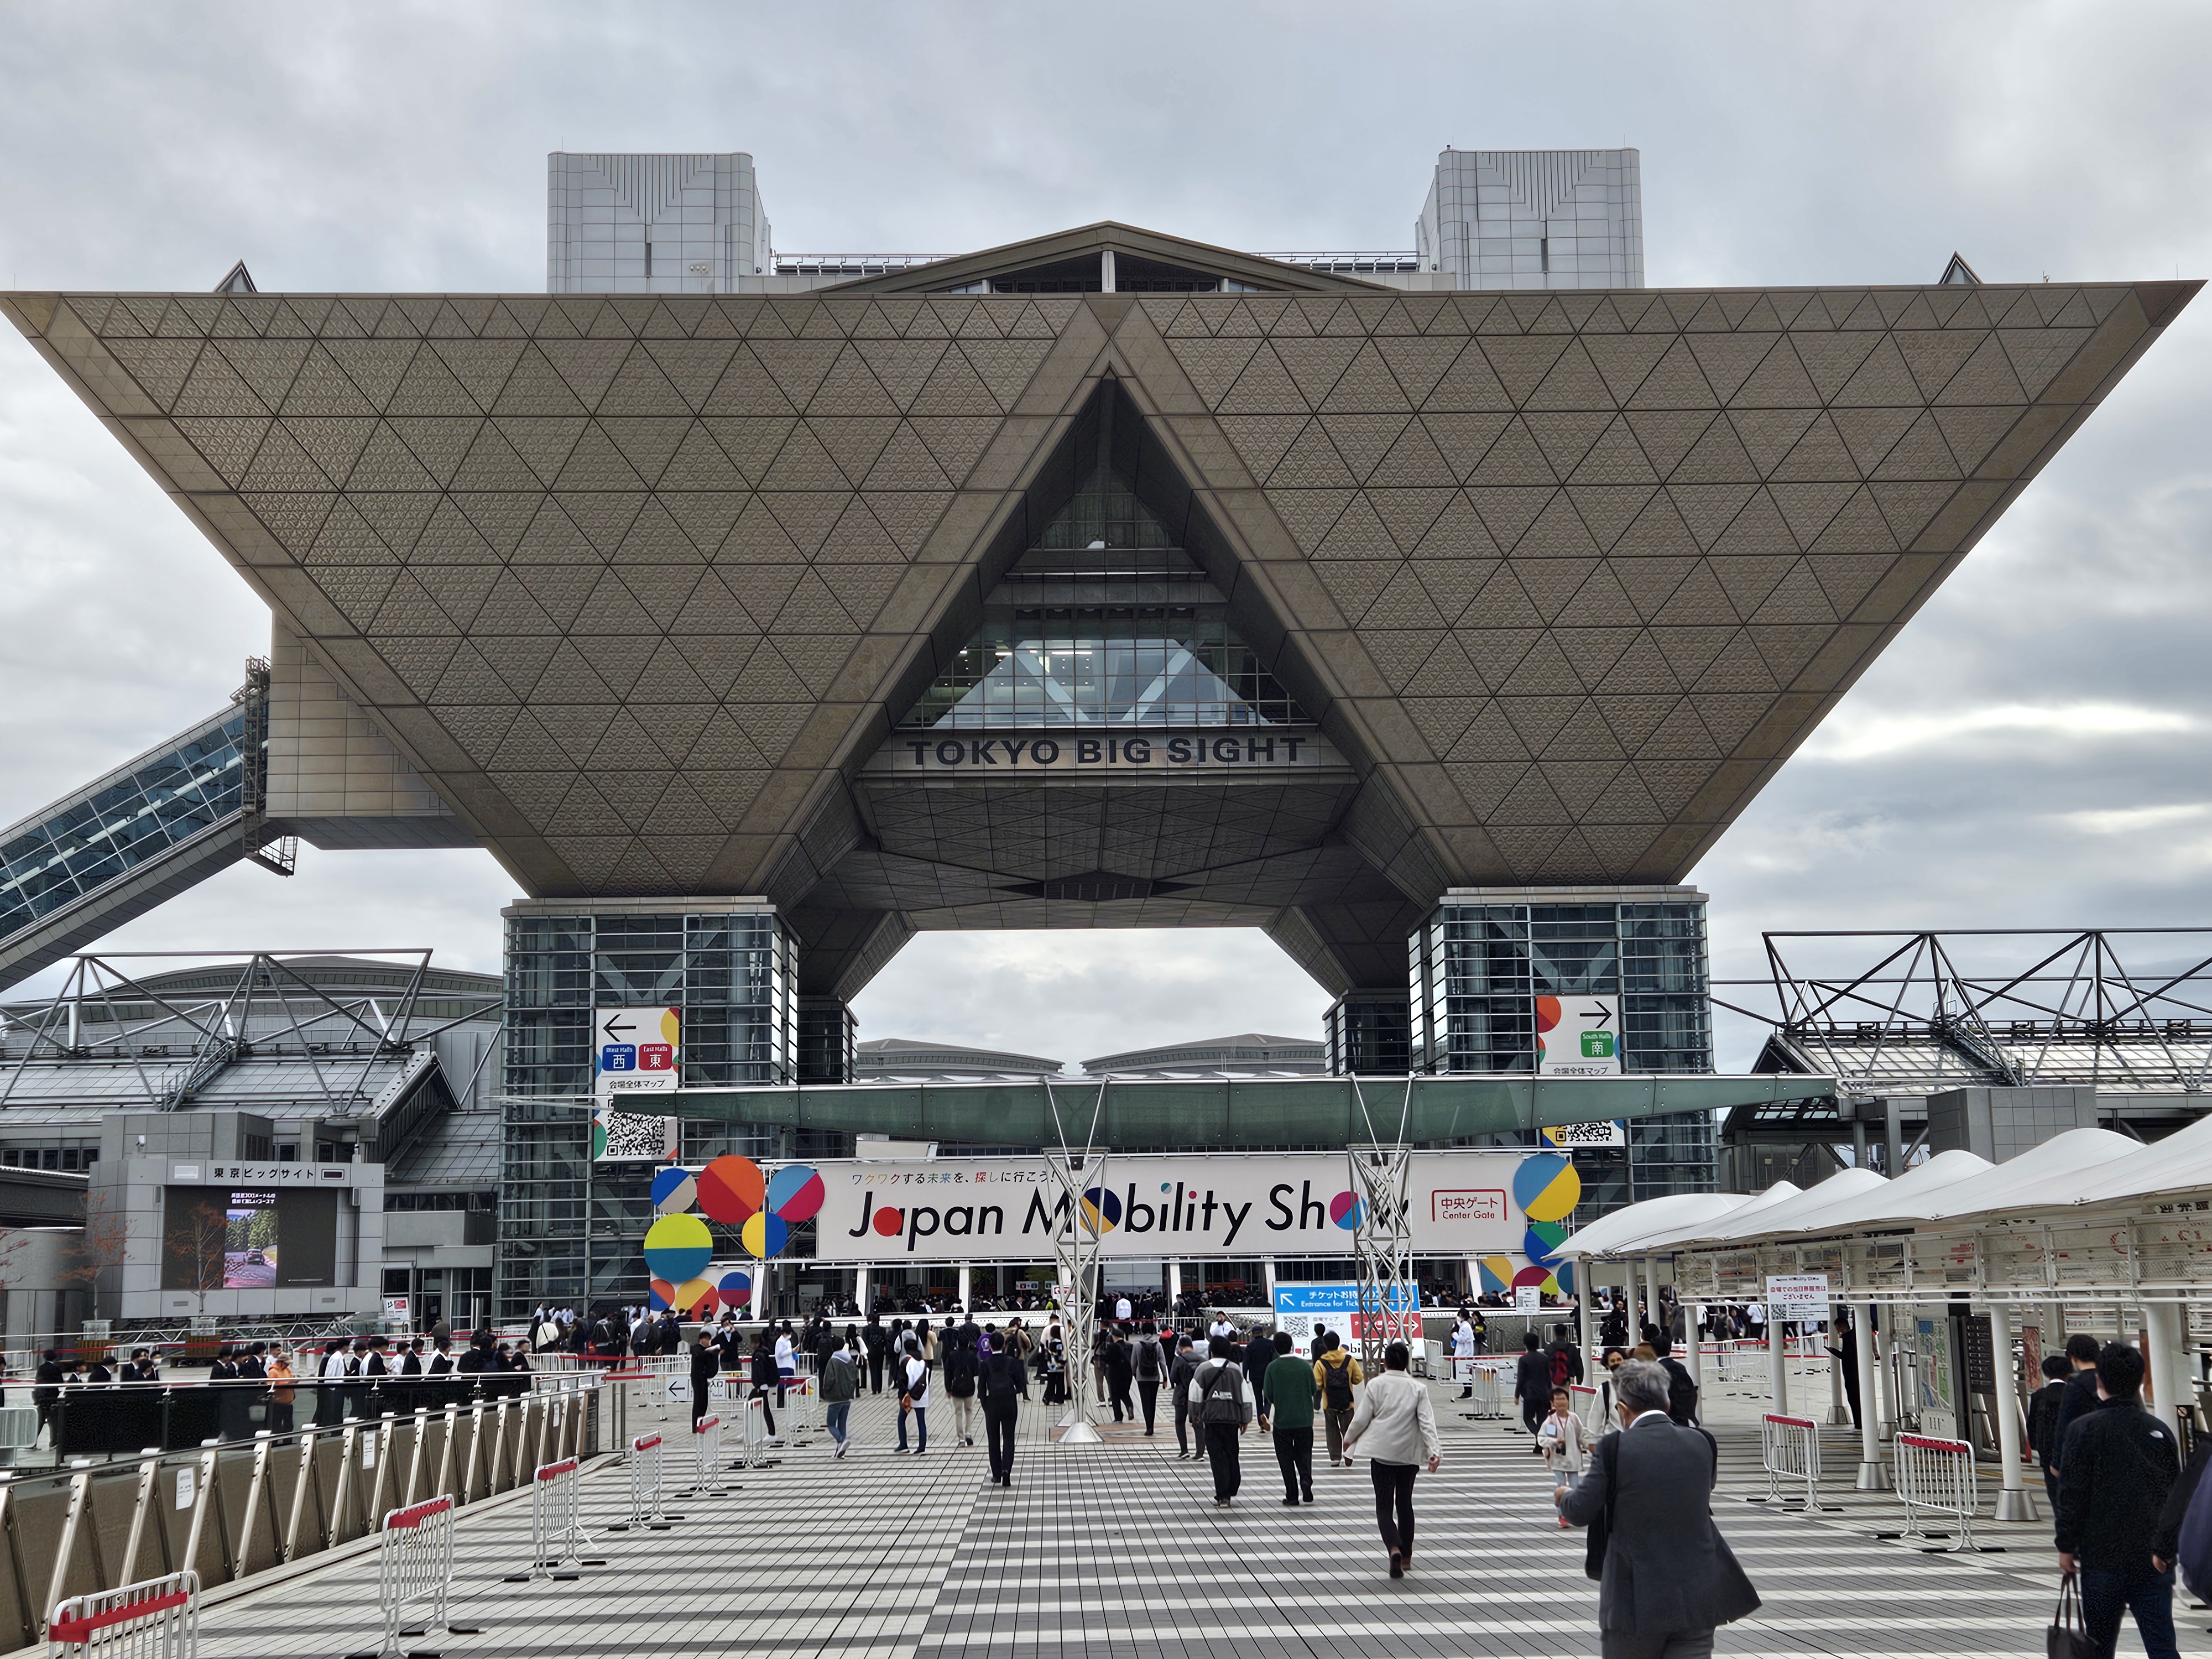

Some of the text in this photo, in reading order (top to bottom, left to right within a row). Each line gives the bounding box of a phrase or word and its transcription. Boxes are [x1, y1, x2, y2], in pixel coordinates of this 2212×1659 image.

[906, 737, 1306, 765] TOKYO BIG SIGHT
[1592, 1041, 1603, 1055] 南
[613, 1055, 625, 1069] 西
[649, 1054, 661, 1068] 東
[1441, 1196, 1498, 1209] 中央ゲート
[848, 1191, 1004, 1251] Japan
[1442, 1210, 1495, 1219] Center Gate
